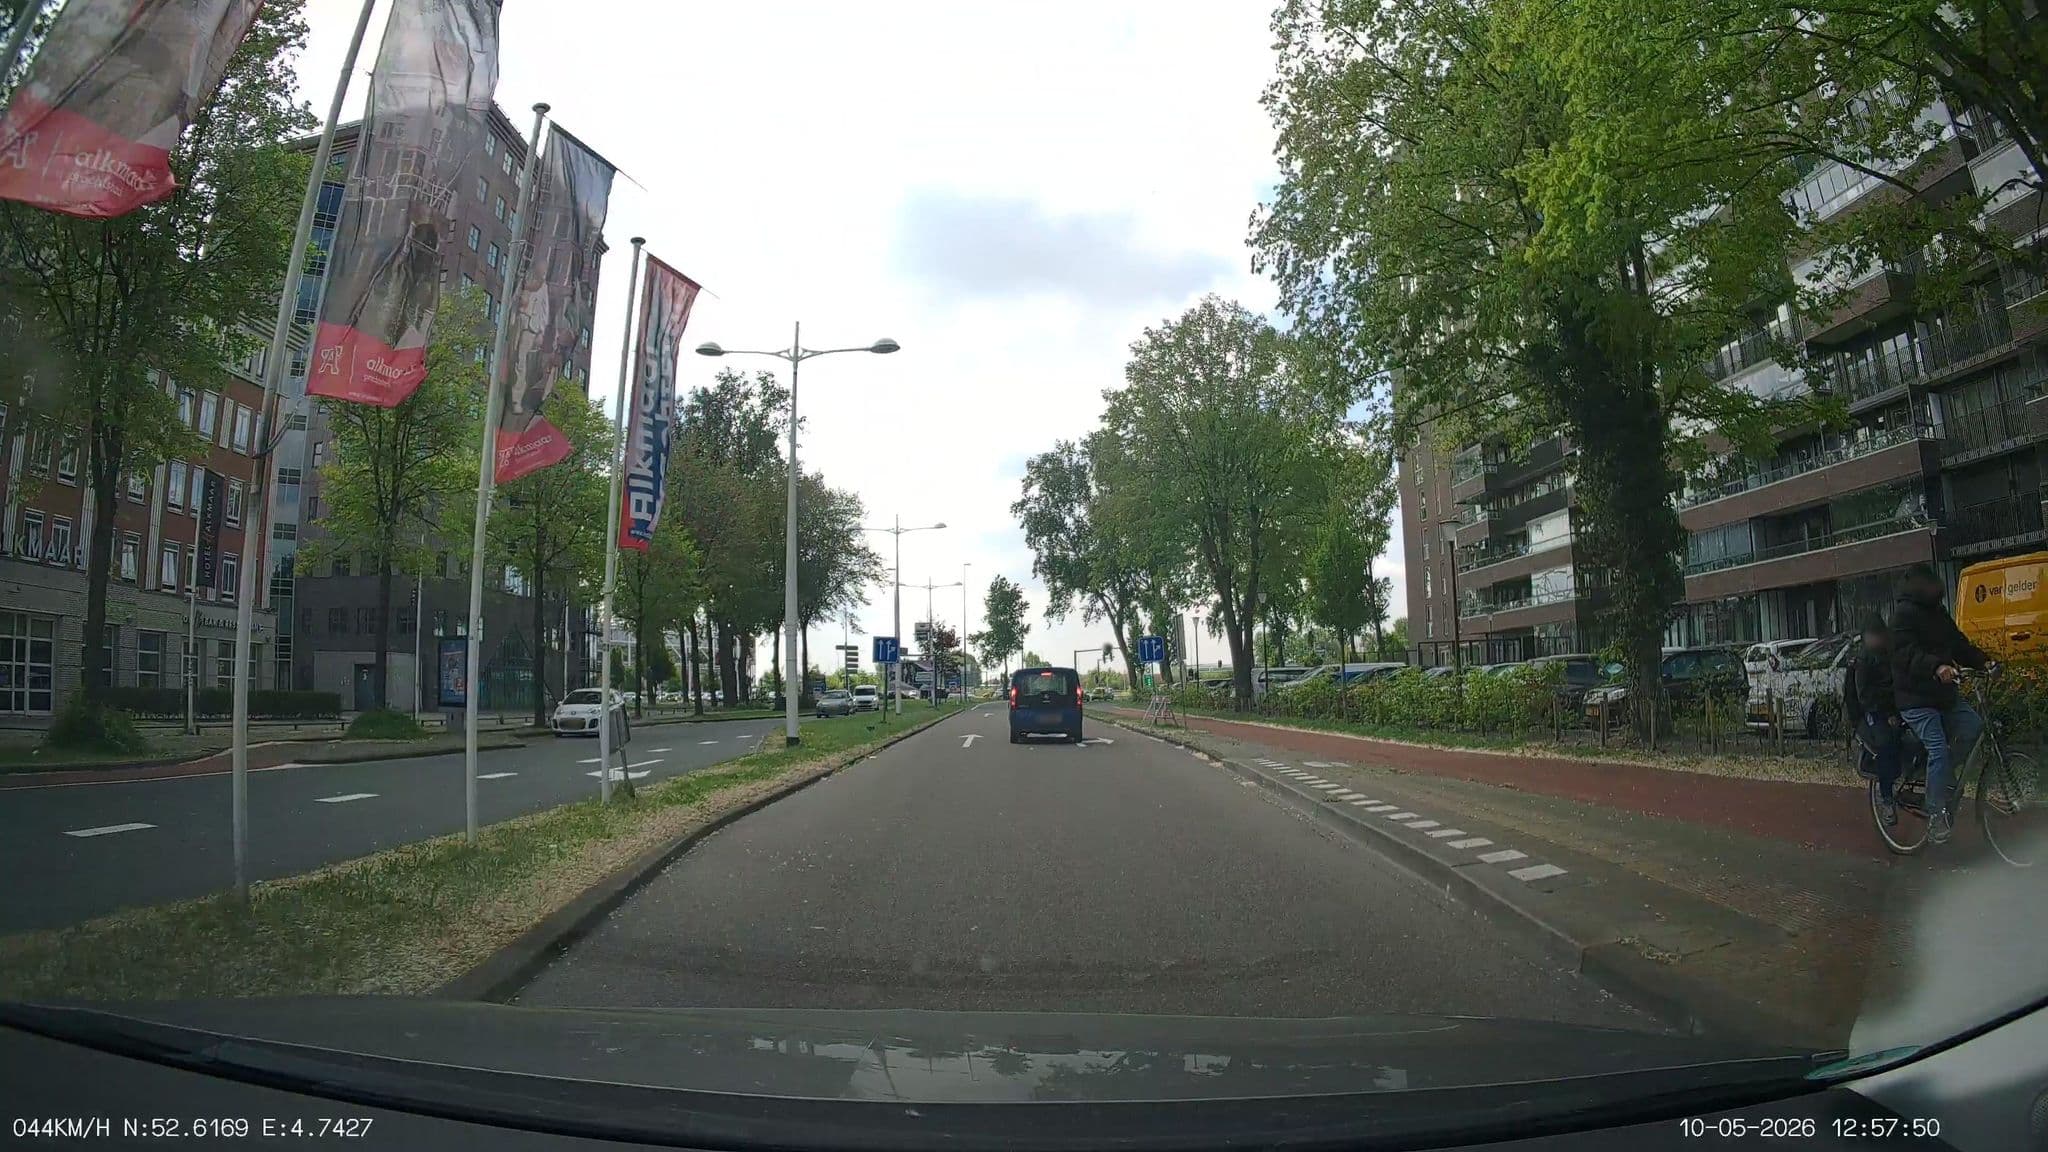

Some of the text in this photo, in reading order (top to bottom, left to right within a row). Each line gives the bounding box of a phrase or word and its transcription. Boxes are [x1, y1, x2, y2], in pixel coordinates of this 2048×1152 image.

[75, 149, 155, 191] alkmaa
[366, 357, 417, 379] alkma
[203, 480, 217, 578] HOTEL ALKMAAR
[2007, 580, 2039, 596] gelder
